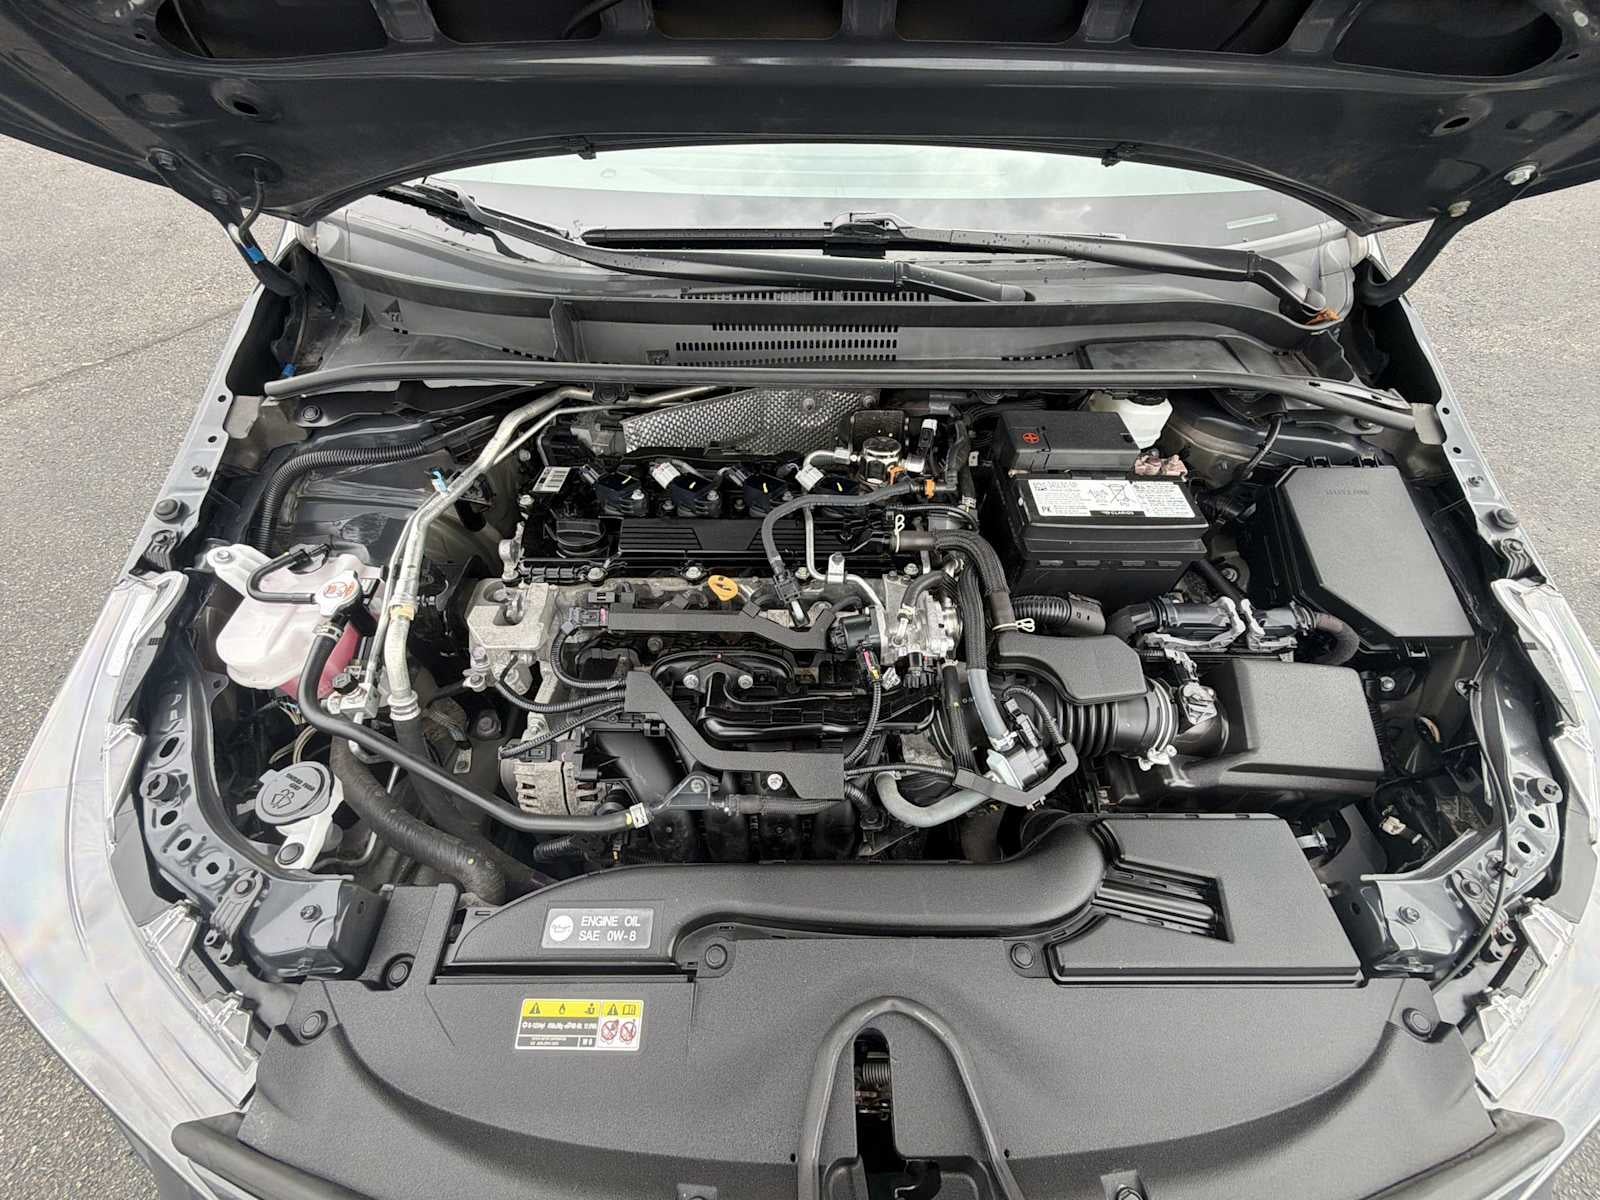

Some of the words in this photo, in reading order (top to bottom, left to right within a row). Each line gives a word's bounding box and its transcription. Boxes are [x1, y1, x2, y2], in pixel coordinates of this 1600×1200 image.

[581, 915, 619, 927] ENGINE
[624, 915, 641, 927] OIL
[578, 930, 600, 942] SAE
[607, 930, 637, 942] 0W-8
